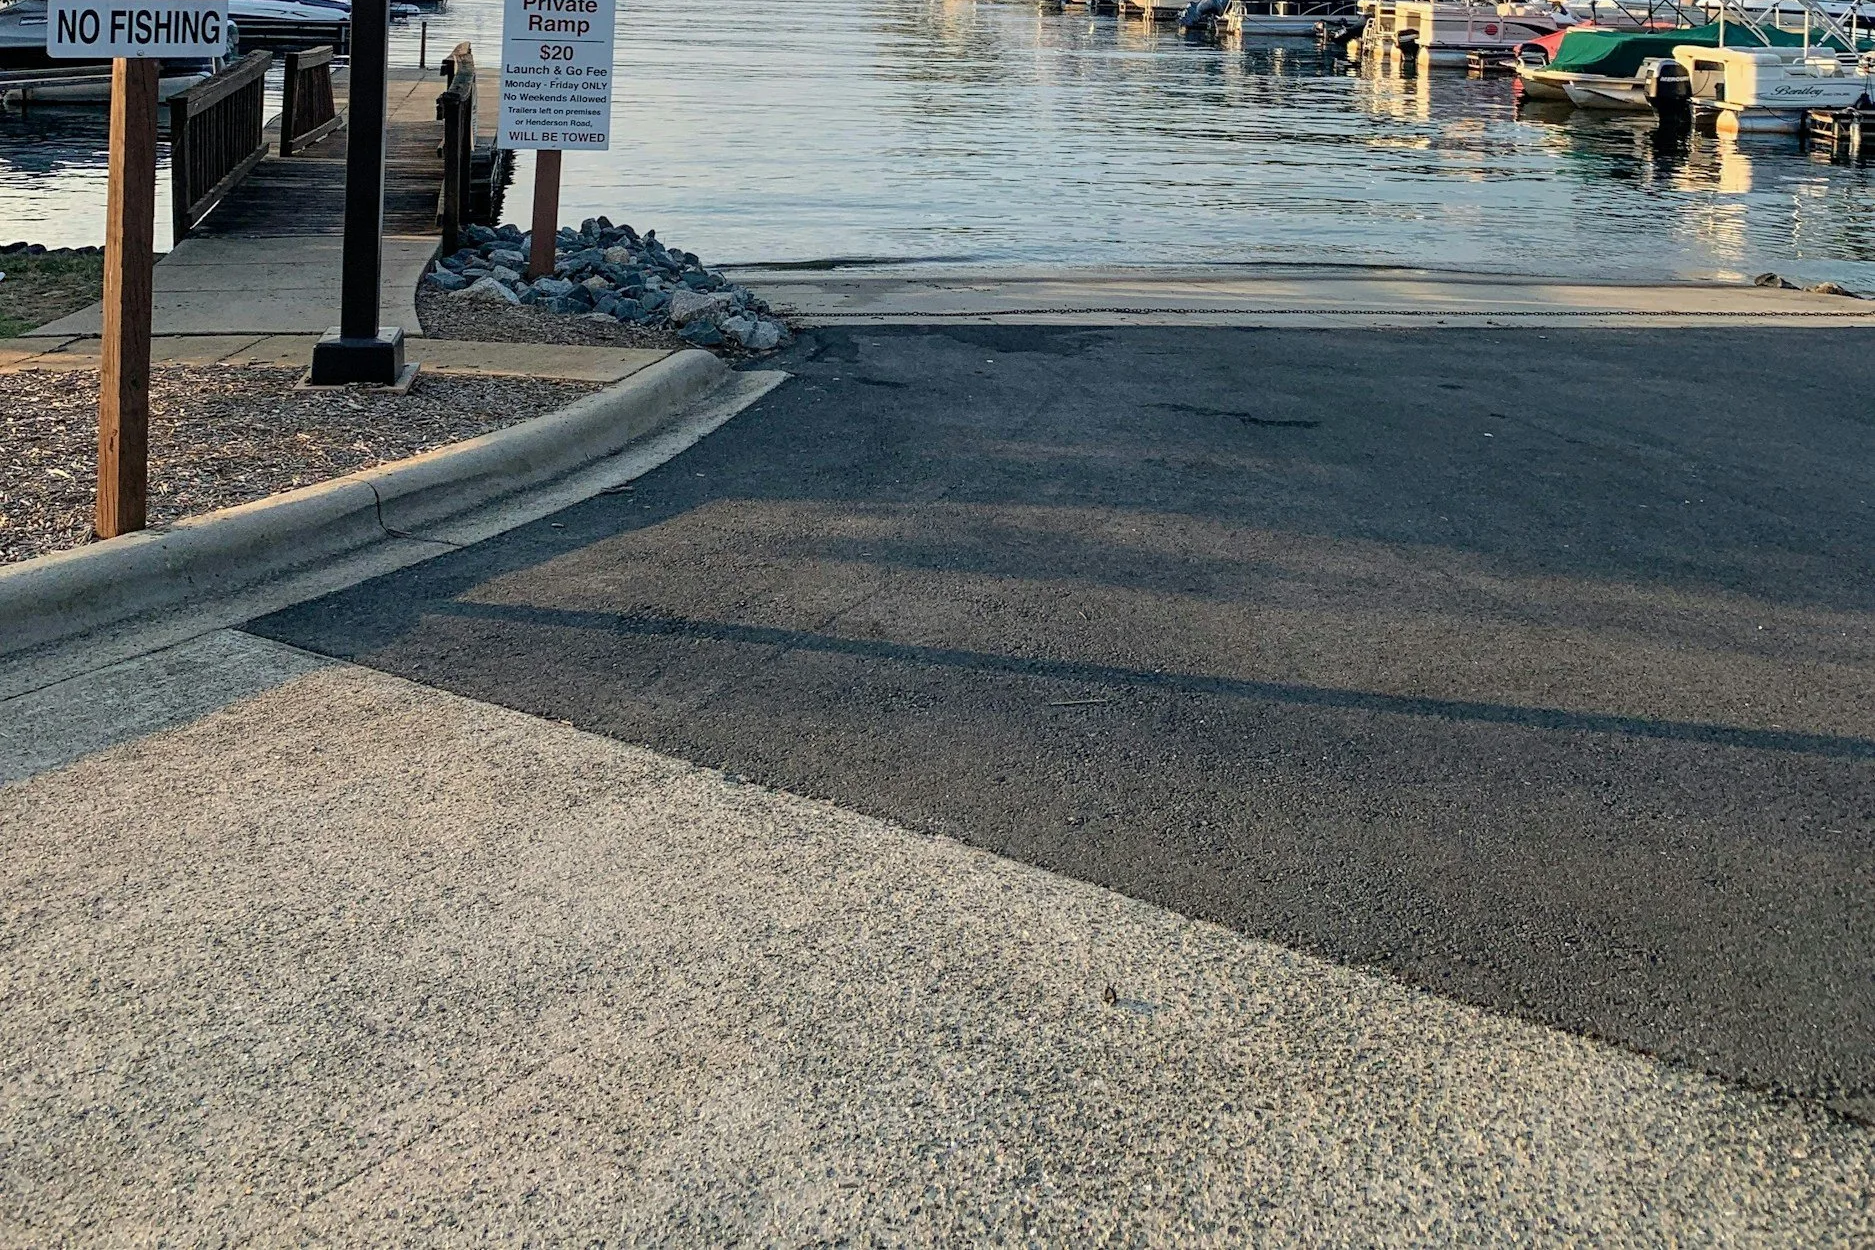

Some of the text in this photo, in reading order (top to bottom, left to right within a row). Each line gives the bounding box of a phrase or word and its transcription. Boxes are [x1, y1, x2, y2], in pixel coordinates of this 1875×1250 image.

[57, 9, 220, 44] NO FISHING
[528, 14, 590, 37] Ramp
[539, 44, 574, 61] $20
[506, 64, 608, 77] Launch & Go Fee
[505, 80, 542, 90] Monday
[550, 81, 579, 92] Friday
[581, 81, 608, 91] ONLY
[1770, 85, 1824, 97] Bentley
[504, 93, 607, 104] No Weekends Allowed
[508, 106, 537, 114] Trailers
[539, 107, 552, 115] left
[565, 108, 601, 117] premises
[525, 119, 568, 127] Henderson
[509, 131, 606, 143] WILL BE TOWED
